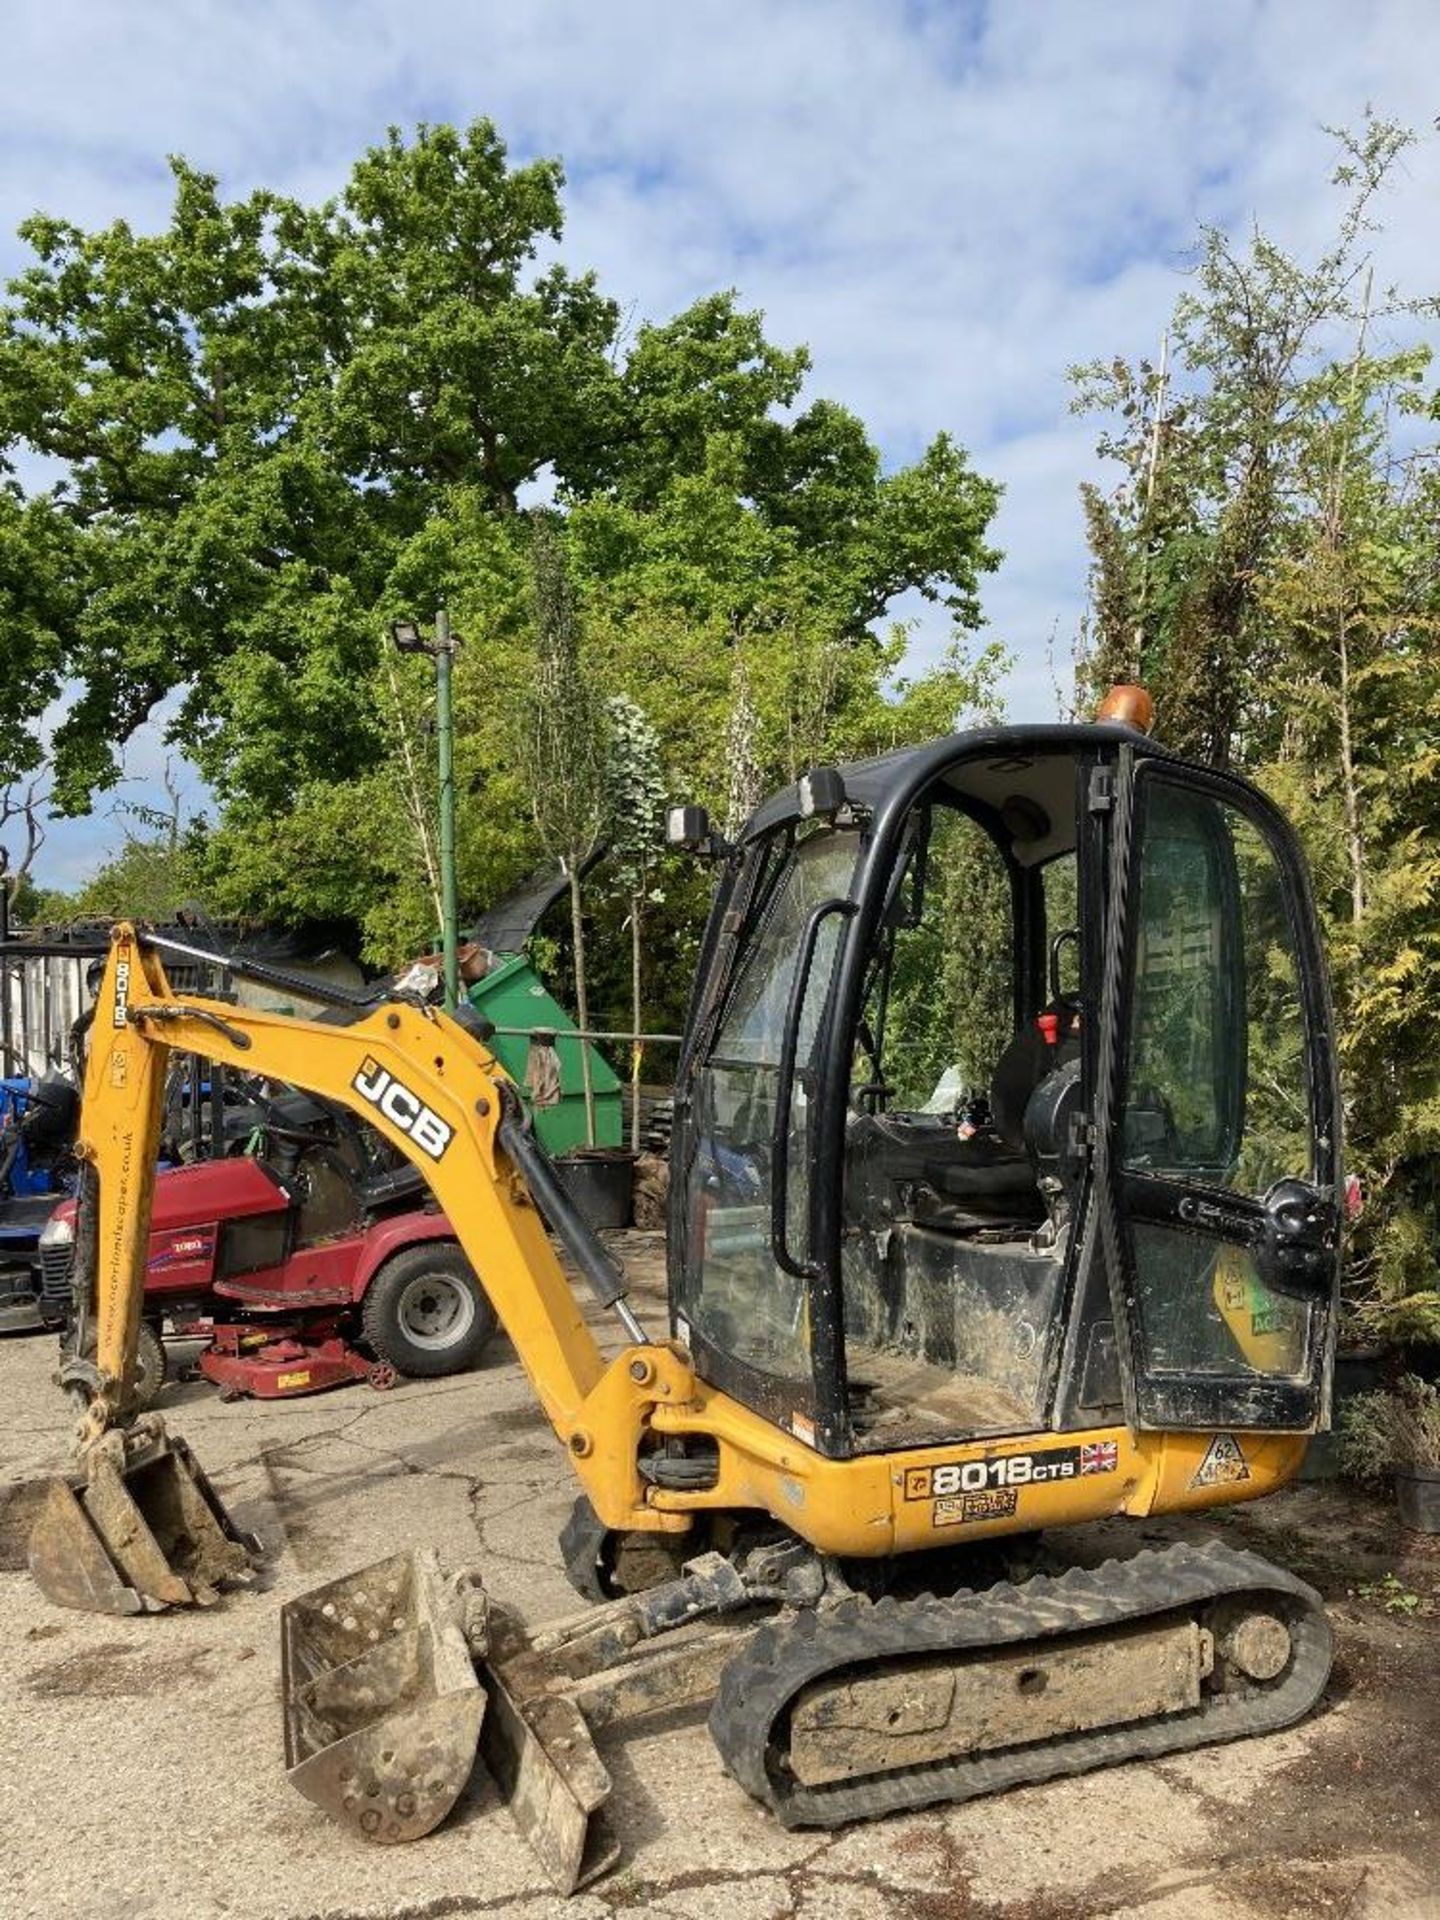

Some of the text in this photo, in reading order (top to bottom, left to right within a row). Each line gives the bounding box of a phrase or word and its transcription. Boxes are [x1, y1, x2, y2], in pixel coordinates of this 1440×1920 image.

[114, 963, 129, 1019] 8018
[354, 1070, 450, 1157] JCB
[1215, 1442, 1233, 1460] 62
